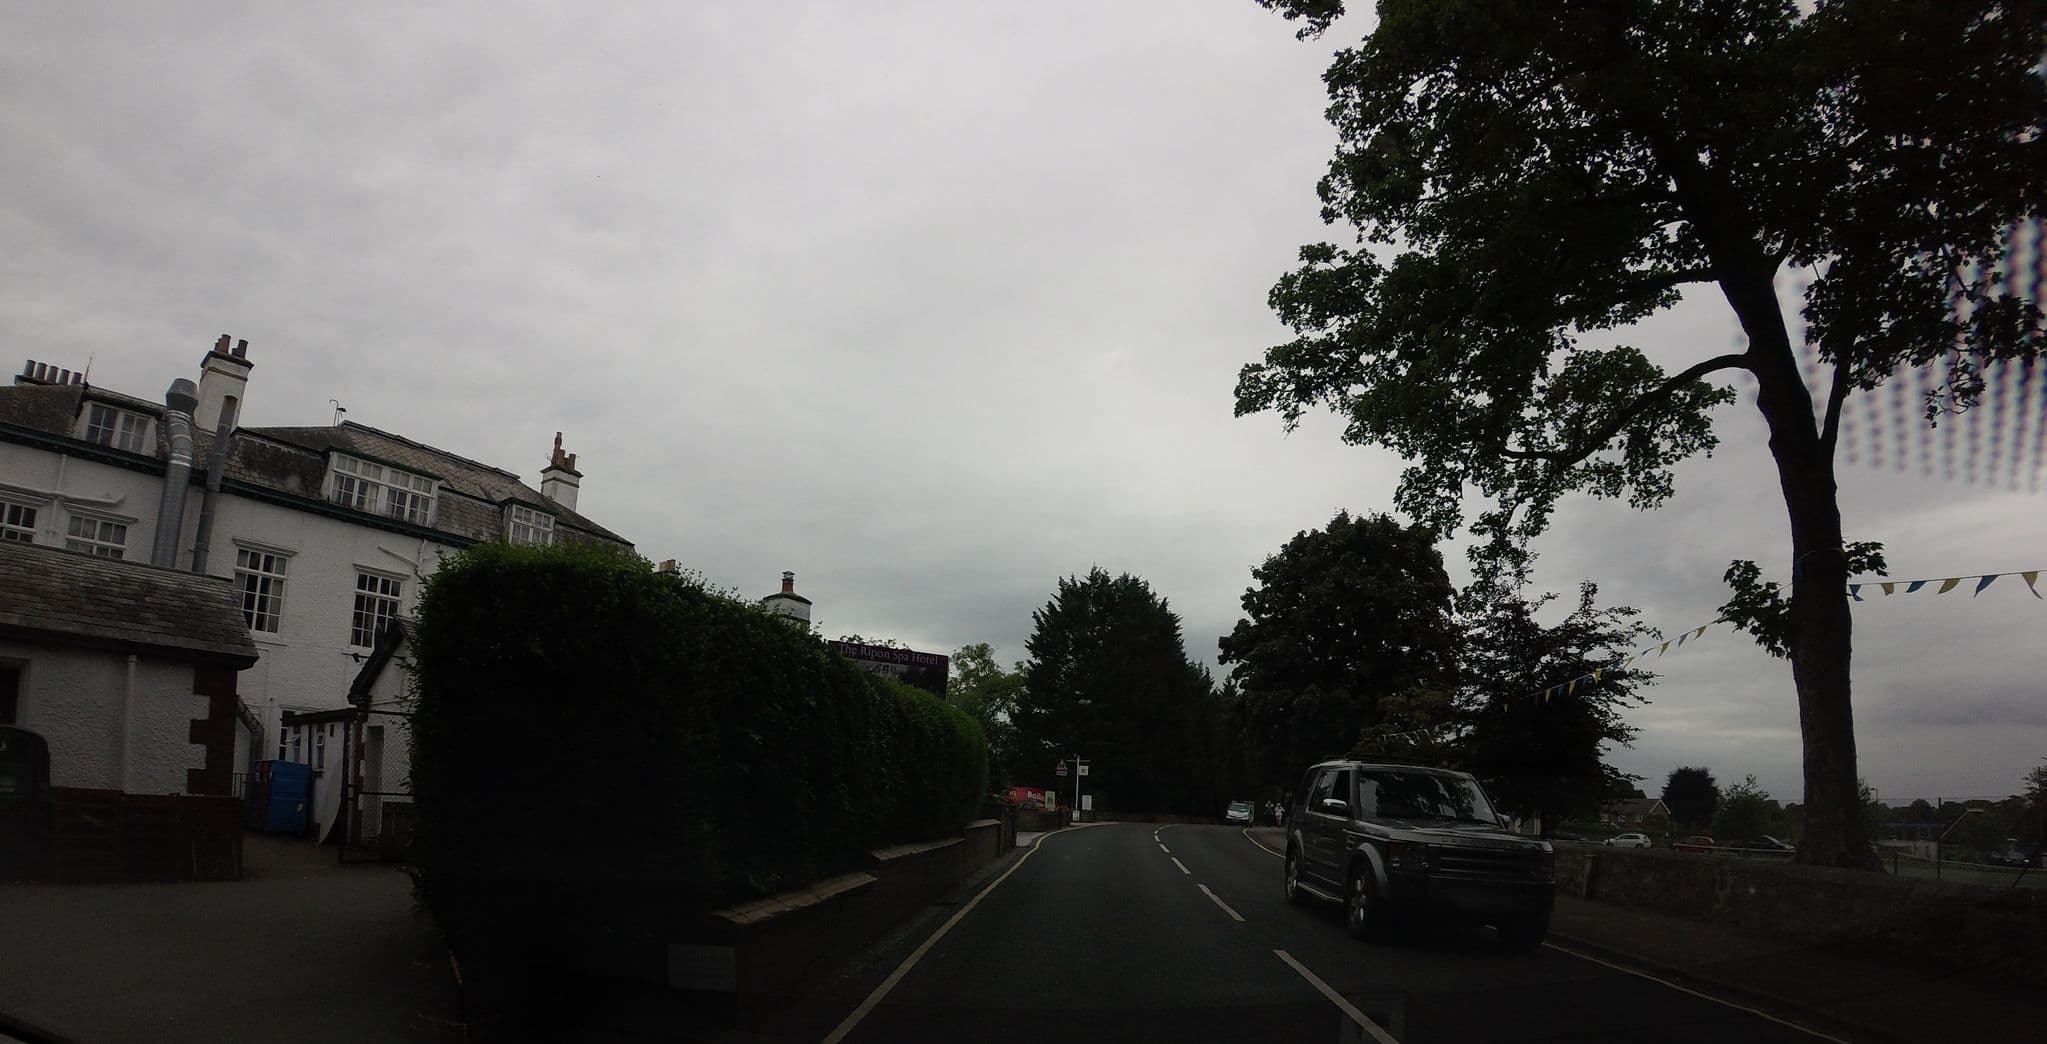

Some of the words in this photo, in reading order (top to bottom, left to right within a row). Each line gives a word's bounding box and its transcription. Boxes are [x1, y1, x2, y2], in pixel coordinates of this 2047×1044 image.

[840, 643, 858, 657] The
[860, 646, 890, 661] Ripon
[892, 650, 909, 664] Spa
[912, 653, 938, 665] Hotel
